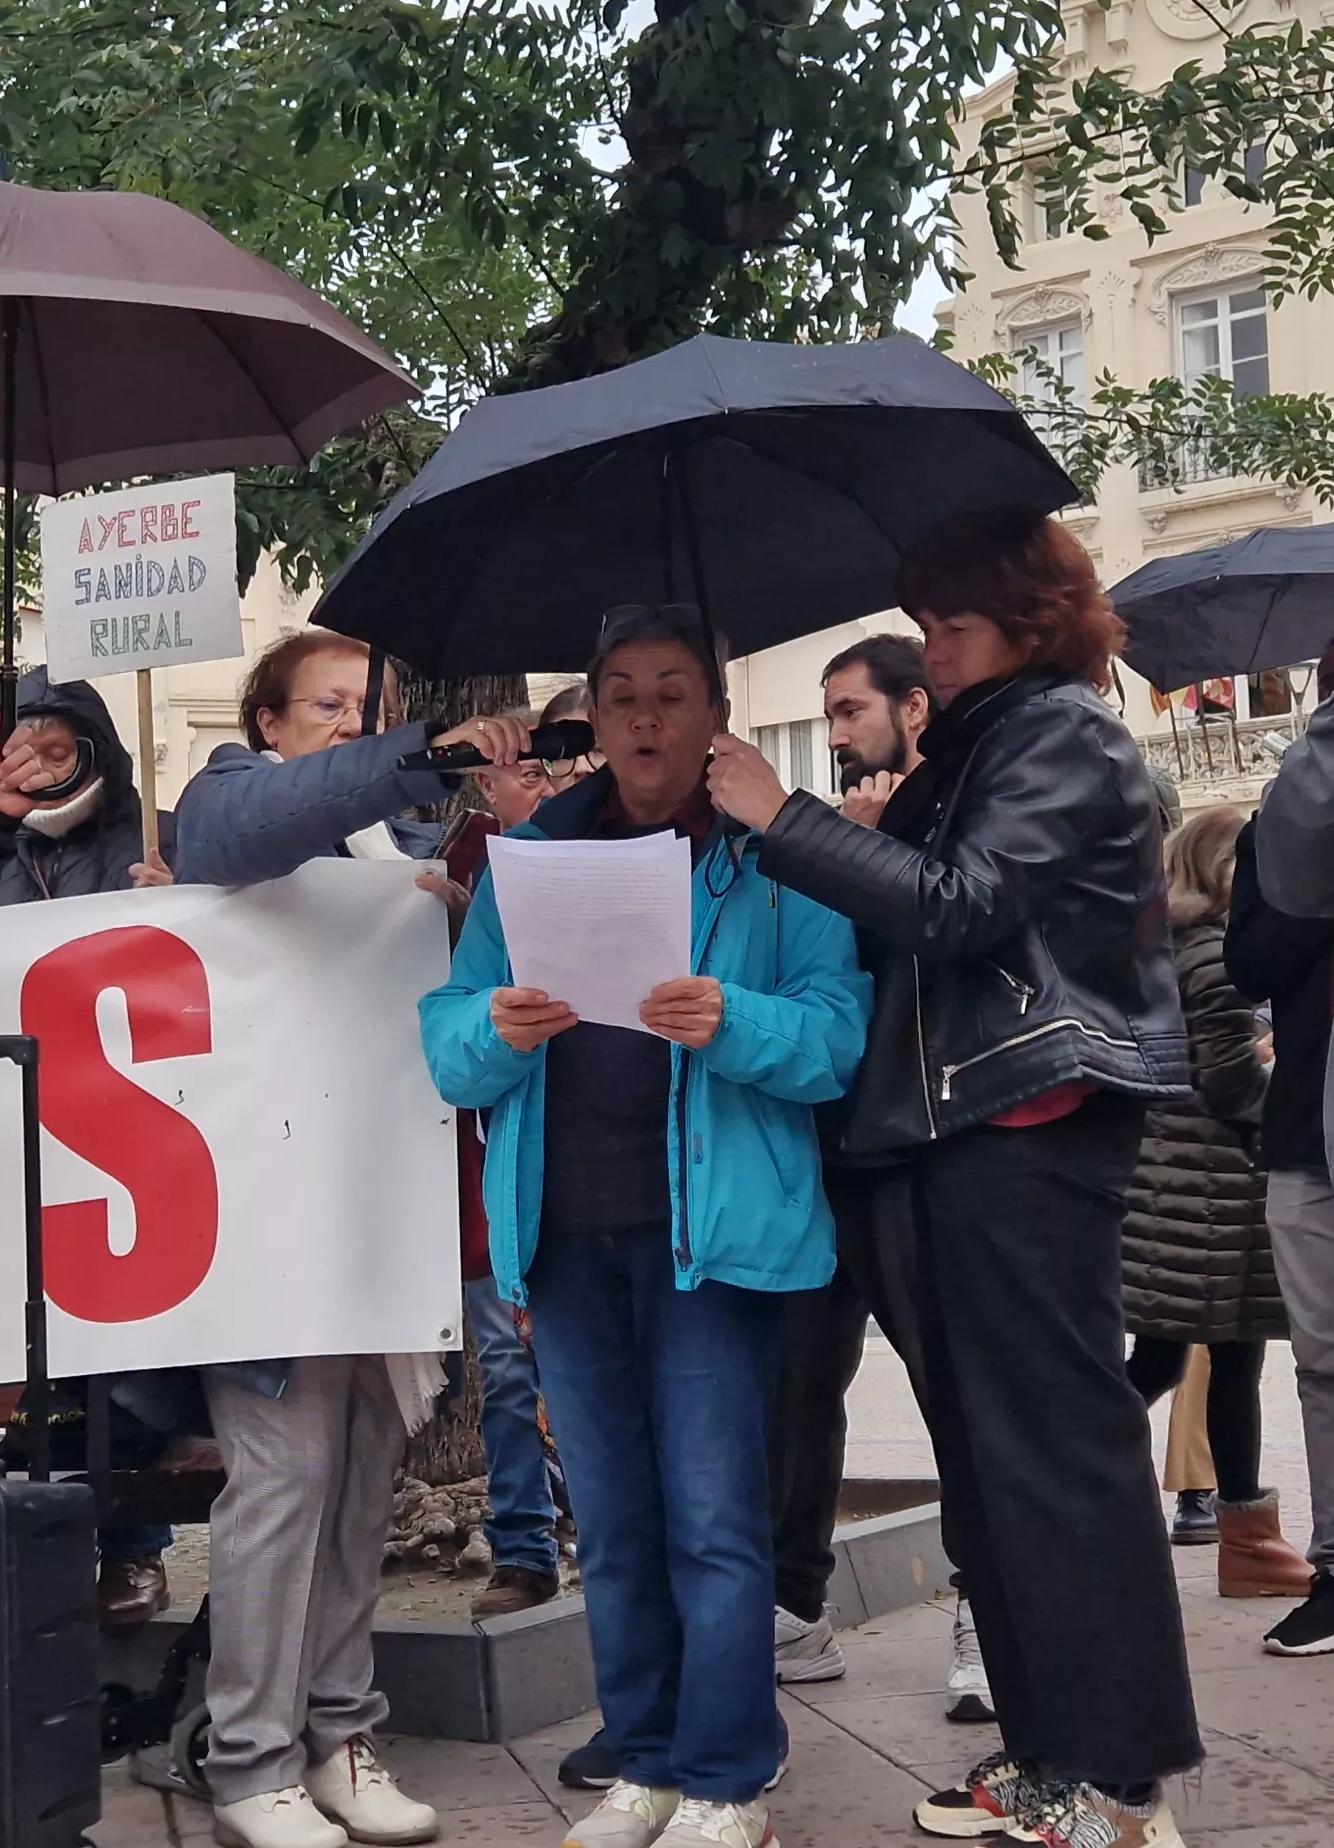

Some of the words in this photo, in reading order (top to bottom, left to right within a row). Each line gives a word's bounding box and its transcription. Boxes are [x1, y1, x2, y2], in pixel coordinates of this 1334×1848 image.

[78, 500, 201, 554] AYERBE
[74, 553, 207, 605] SANIDAD
[90, 610, 193, 658] RURAL
